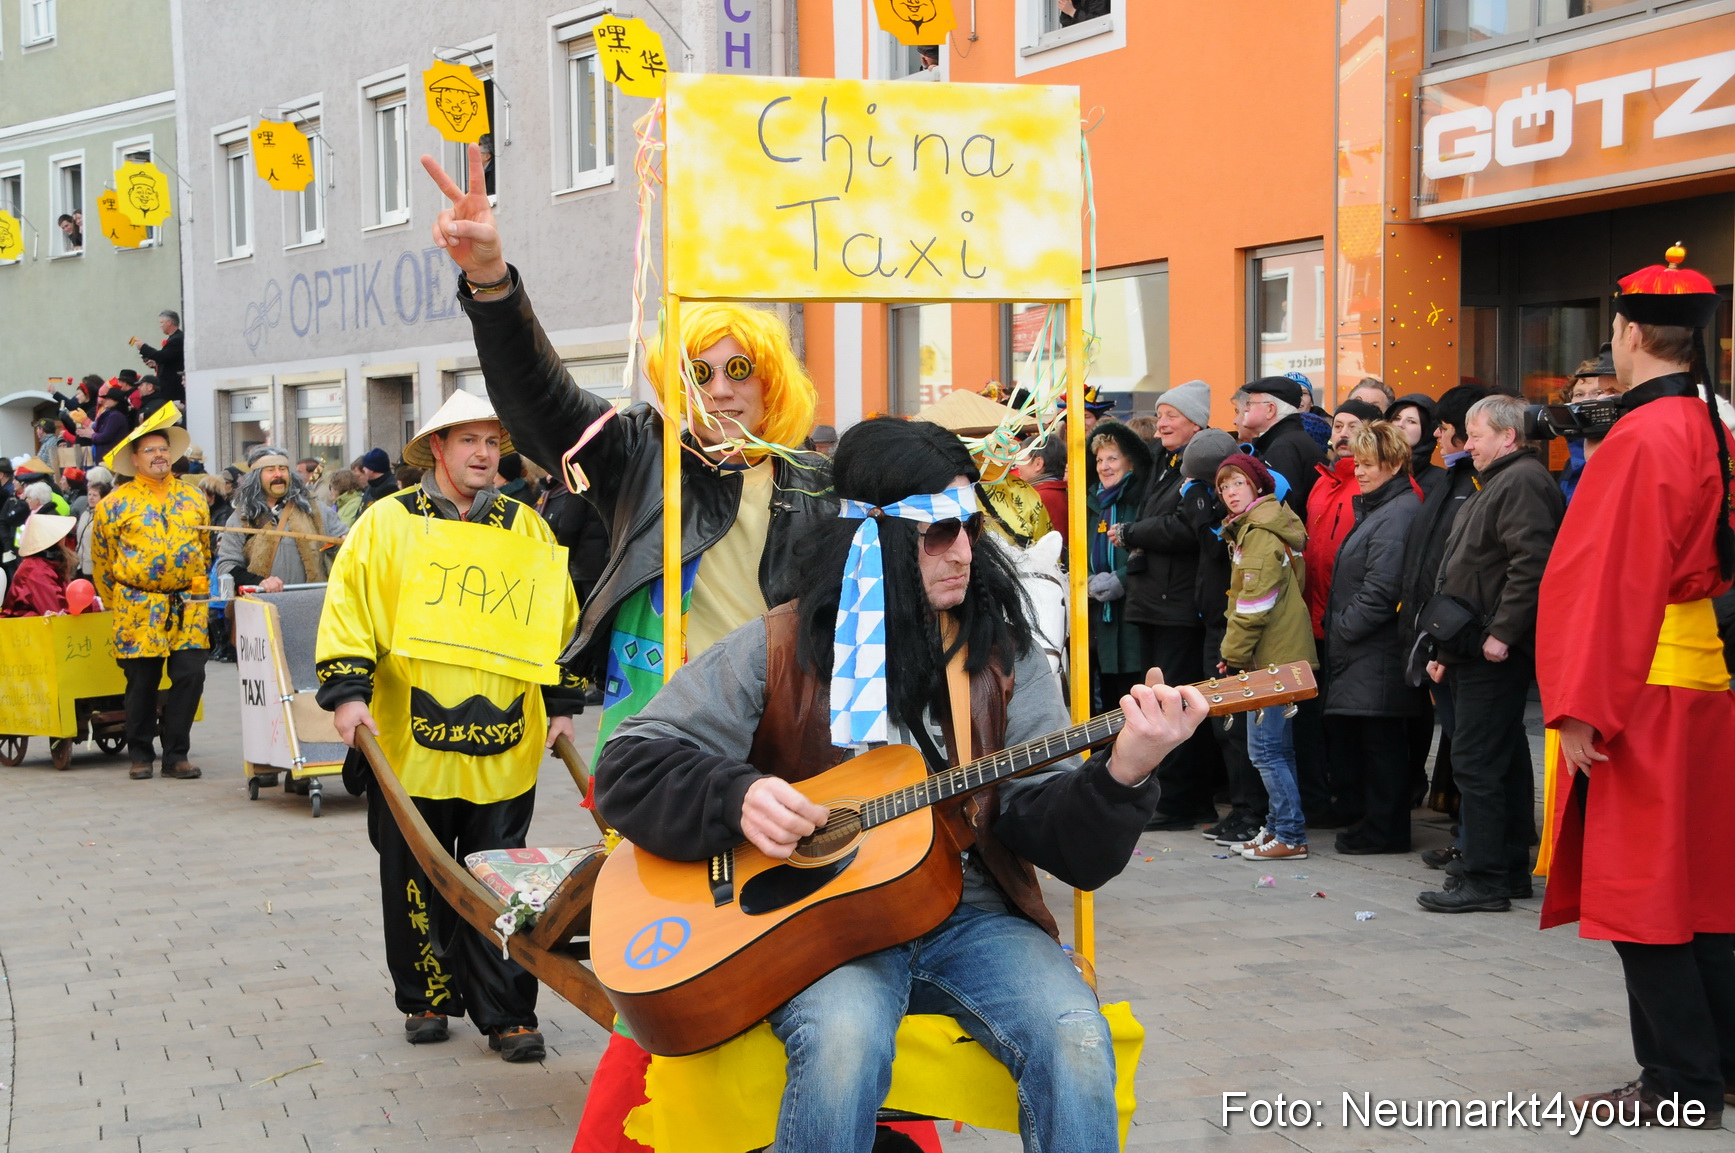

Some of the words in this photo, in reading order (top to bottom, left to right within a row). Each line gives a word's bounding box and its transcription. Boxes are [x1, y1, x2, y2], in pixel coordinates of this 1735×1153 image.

[758, 96, 1014, 193] China
[1423, 50, 1735, 180] GÖTZ
[776, 196, 987, 279] Taxi
[289, 260, 386, 338] OPTIK
[242, 679, 266, 707] TAXI
